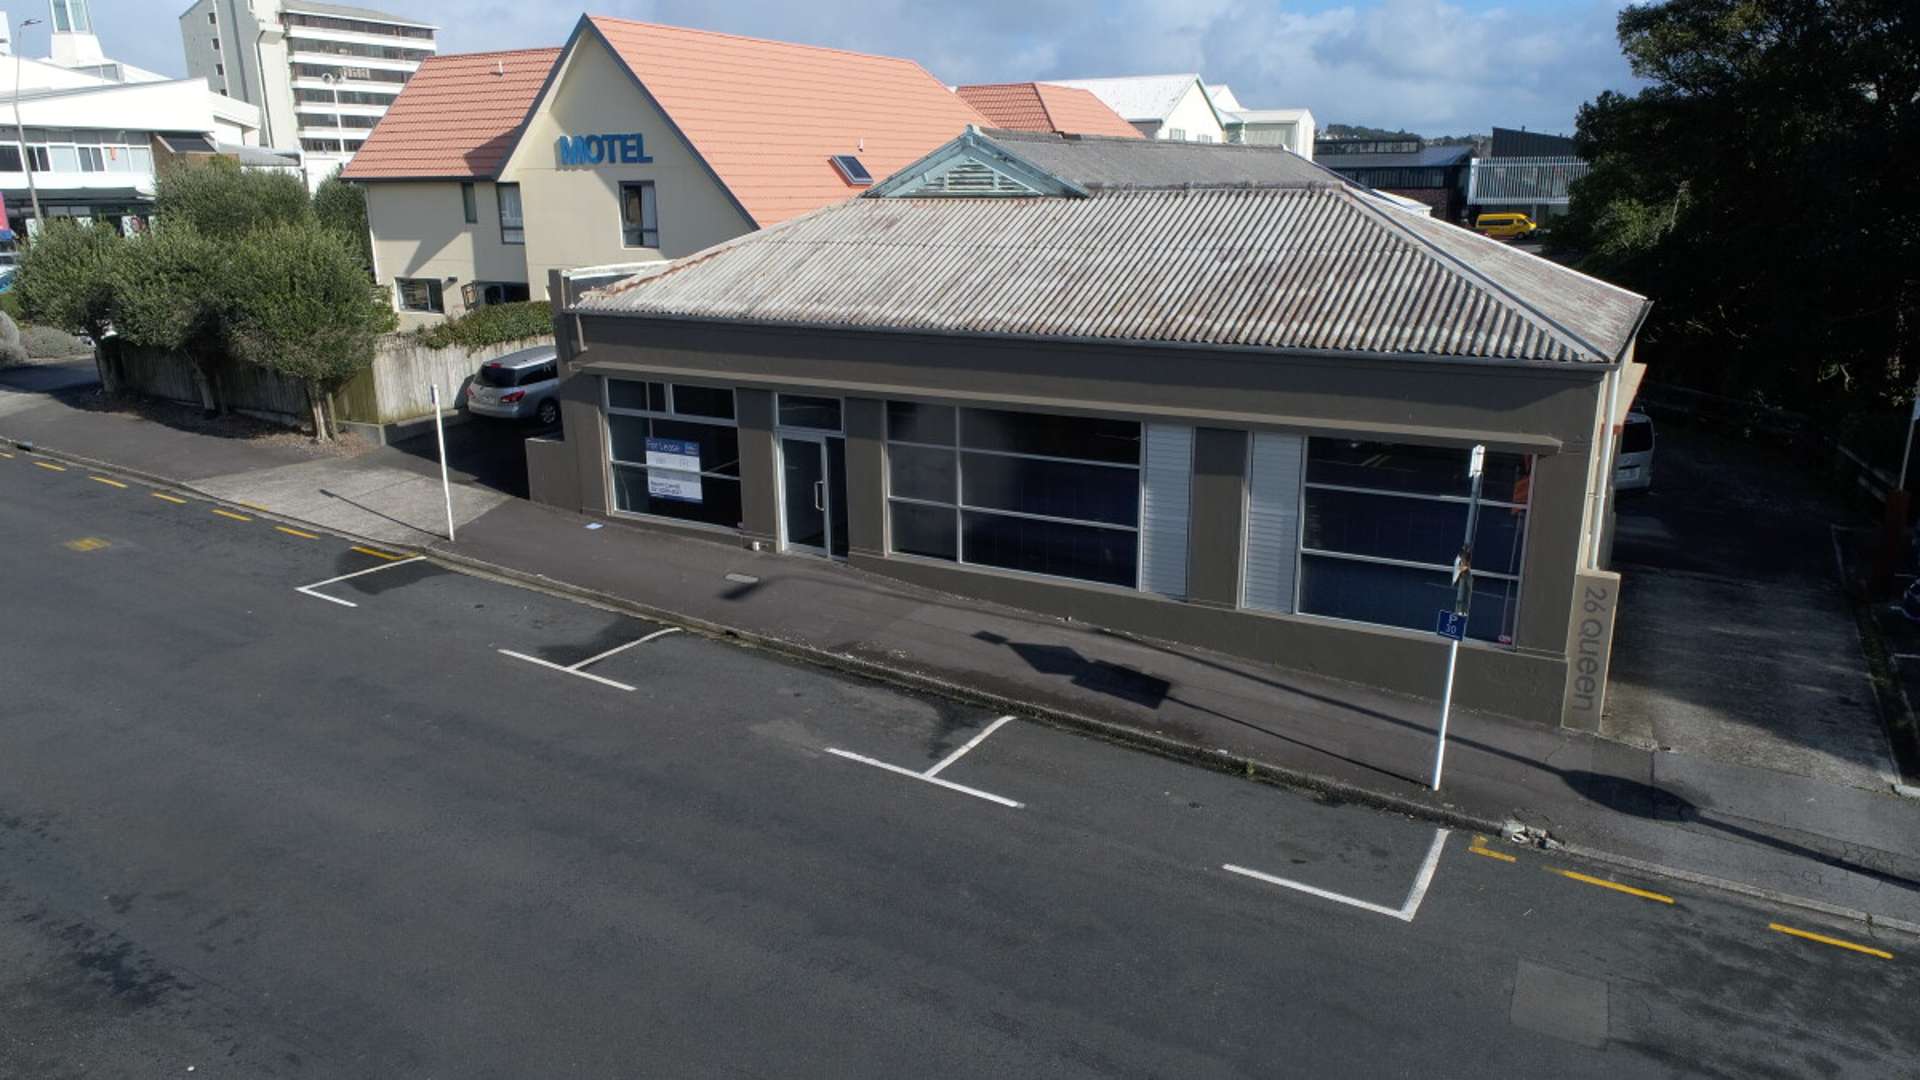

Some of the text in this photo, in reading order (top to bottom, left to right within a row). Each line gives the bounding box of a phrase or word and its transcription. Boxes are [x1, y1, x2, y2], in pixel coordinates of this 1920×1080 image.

[557, 132, 653, 165] MOTEL
[1446, 624, 1457, 634] 30
[1449, 613, 1458, 624] P
[1572, 586, 1608, 711] 26 Queen
